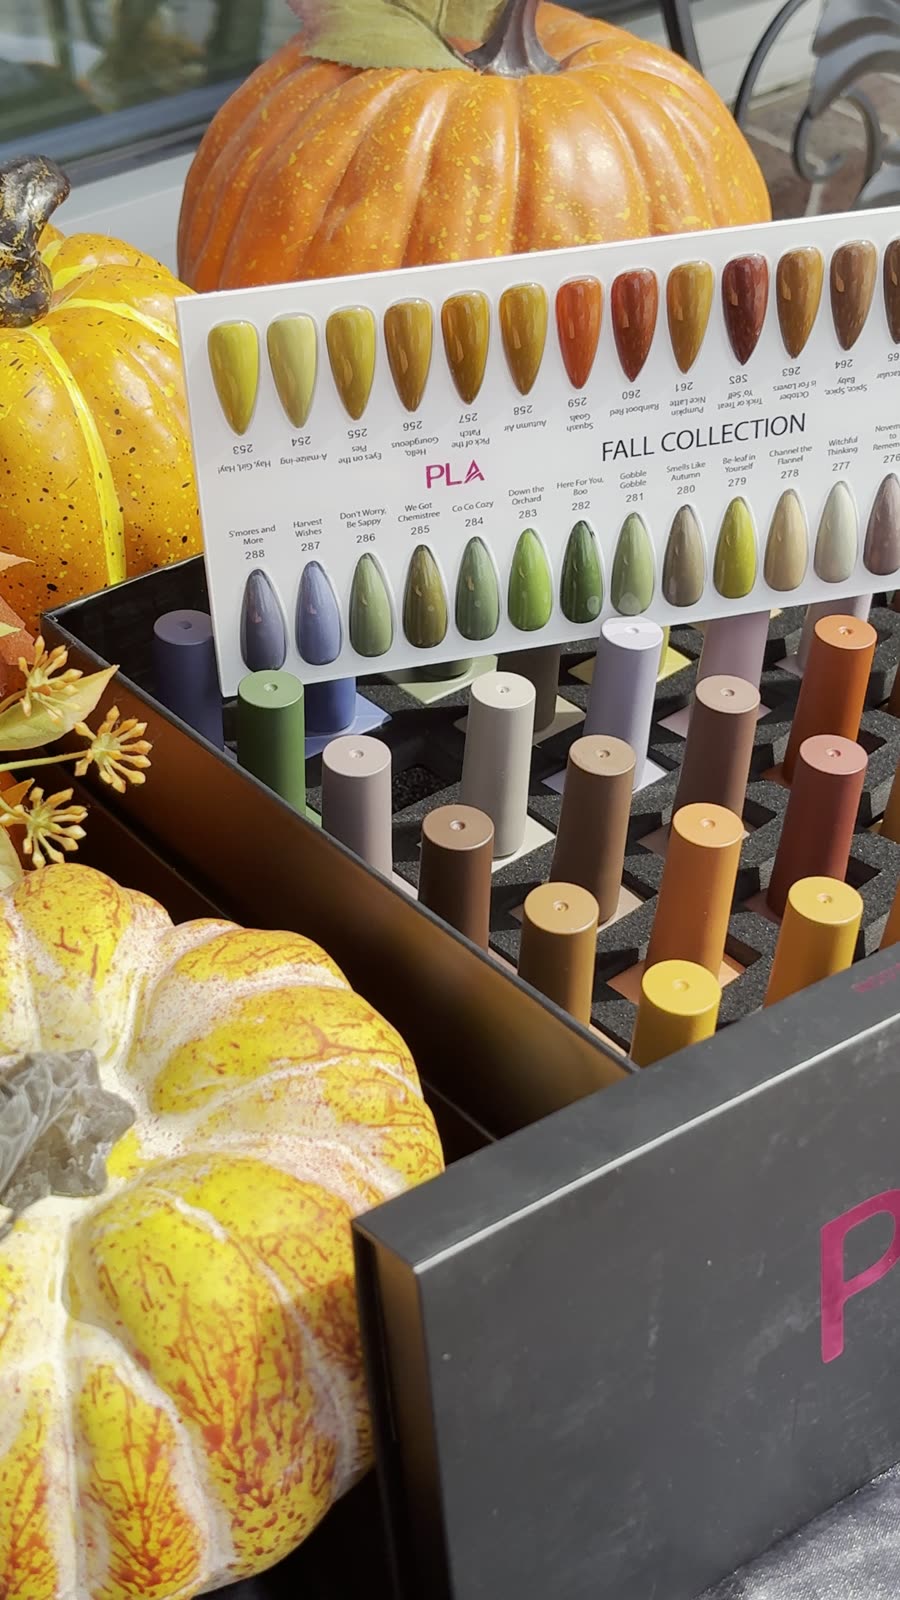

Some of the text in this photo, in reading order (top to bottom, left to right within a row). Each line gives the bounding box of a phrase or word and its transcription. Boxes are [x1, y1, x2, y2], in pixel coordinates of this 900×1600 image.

[888, 352, 900, 362] 65
[835, 359, 853, 369] 264
[782, 366, 801, 377] 263
[798, 381, 810, 389] For
[837, 376, 856, 384] Baby
[676, 382, 693, 392] 261
[622, 390, 640, 400] 260
[690, 396, 706, 404] Nice
[728, 391, 742, 400] Self
[780, 391, 809, 400] October
[568, 397, 587, 408] 259
[718, 402, 736, 410] Treat
[746, 398, 763, 406] Trick
[514, 405, 533, 416] 258
[610, 404, 659, 416] Rainboot Red
[671, 406, 704, 416] Pumpkin
[459, 413, 478, 424] 257
[570, 413, 591, 422] Goals
[403, 421, 422, 431] 256
[504, 420, 547, 432] Autumn Air
[567, 422, 594, 432] Squash
[348, 428, 368, 439] 255
[460, 429, 481, 438] Patch
[602, 413, 806, 462] FALL COLLECTION
[292, 436, 311, 447] 254
[392, 437, 439, 448] Gourgdeous
[466, 440, 474, 448] of
[476, 438, 490, 446] Pick
[829, 436, 858, 447] Witchful
[233, 444, 253, 455] 253
[768, 447, 799, 457] Channel
[828, 447, 858, 456] Thinking
[280, 454, 328, 465] A-maize-ing
[365, 452, 382, 460] Eyes
[723, 454, 748, 465] Be-leaf
[778, 455, 804, 465] Flannel
[883, 454, 900, 464] 276
[218, 464, 235, 474] Hay!
[666, 461, 706, 473] Smells Like
[725, 463, 754, 473] Yourself
[832, 461, 850, 471] 277
[426, 460, 485, 489] PLA
[620, 470, 647, 480] Gobble
[671, 471, 701, 481] Autumn
[781, 469, 799, 479] 278
[556, 481, 575, 489] Here
[620, 480, 647, 489] Gobble
[728, 477, 747, 487] 279
[508, 488, 531, 497] Down
[677, 485, 696, 495] 280
[512, 495, 542, 505] Orchard
[626, 492, 644, 503] 281
[405, 502, 432, 512] We Got
[464, 503, 474, 511] Co
[475, 500, 494, 509] Cozy
[572, 501, 591, 511] 282
[340, 511, 361, 520] Don't
[398, 511, 441, 522] Chemistree
[519, 509, 538, 519] 283
[293, 518, 322, 528] Harvest
[358, 518, 382, 527] Sappy
[465, 517, 484, 527] 284
[229, 524, 276, 538] S'mores and
[295, 528, 322, 537] Wishes
[411, 525, 430, 535] 285
[243, 537, 264, 545] More
[356, 533, 376, 543] 286
[301, 541, 320, 551] 287
[245, 550, 265, 560] 288
